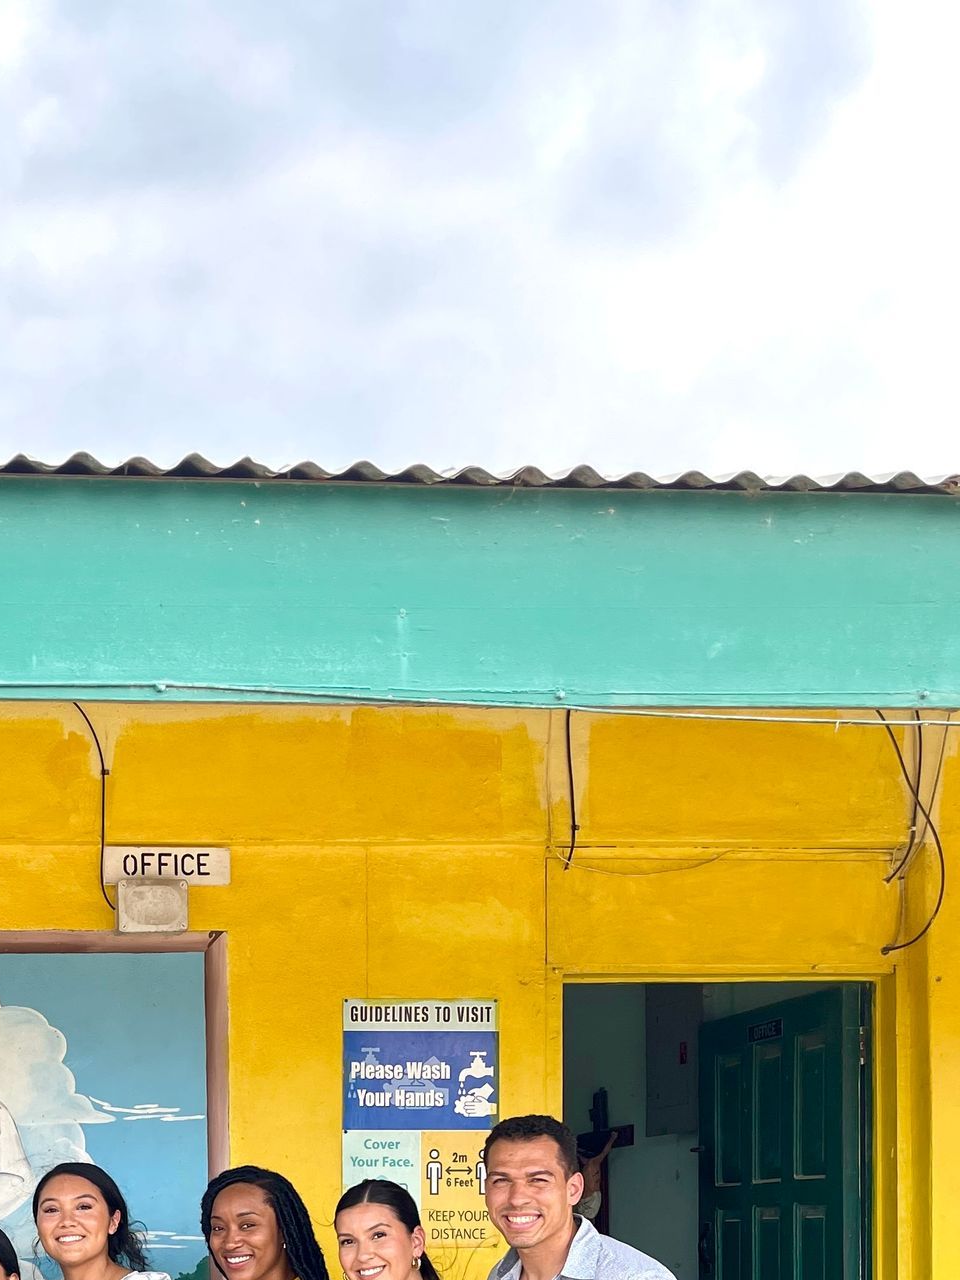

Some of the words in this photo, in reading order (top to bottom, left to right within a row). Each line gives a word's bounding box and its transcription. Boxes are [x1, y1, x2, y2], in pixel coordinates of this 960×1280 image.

[123, 853, 210, 876] OFFICE
[350, 1005, 429, 1023] GUIDELINES
[435, 1006, 451, 1023] TO
[457, 1006, 492, 1023] VISIT
[753, 1022, 777, 1039] OFFICE
[351, 1061, 404, 1080] Please
[406, 1061, 451, 1080] Wash
[357, 1089, 392, 1107] Your
[395, 1089, 444, 1107] Hands
[363, 1139, 400, 1150] Cover
[350, 1156, 380, 1168] Your
[382, 1156, 414, 1168] Face.
[452, 1152, 468, 1163] 2m
[446, 1177, 452, 1187] 6
[454, 1177, 474, 1187] Feet
[428, 1210, 455, 1222] KEEP
[458, 1210, 489, 1222] YOUR
[431, 1228, 486, 1240] DISTANCE
